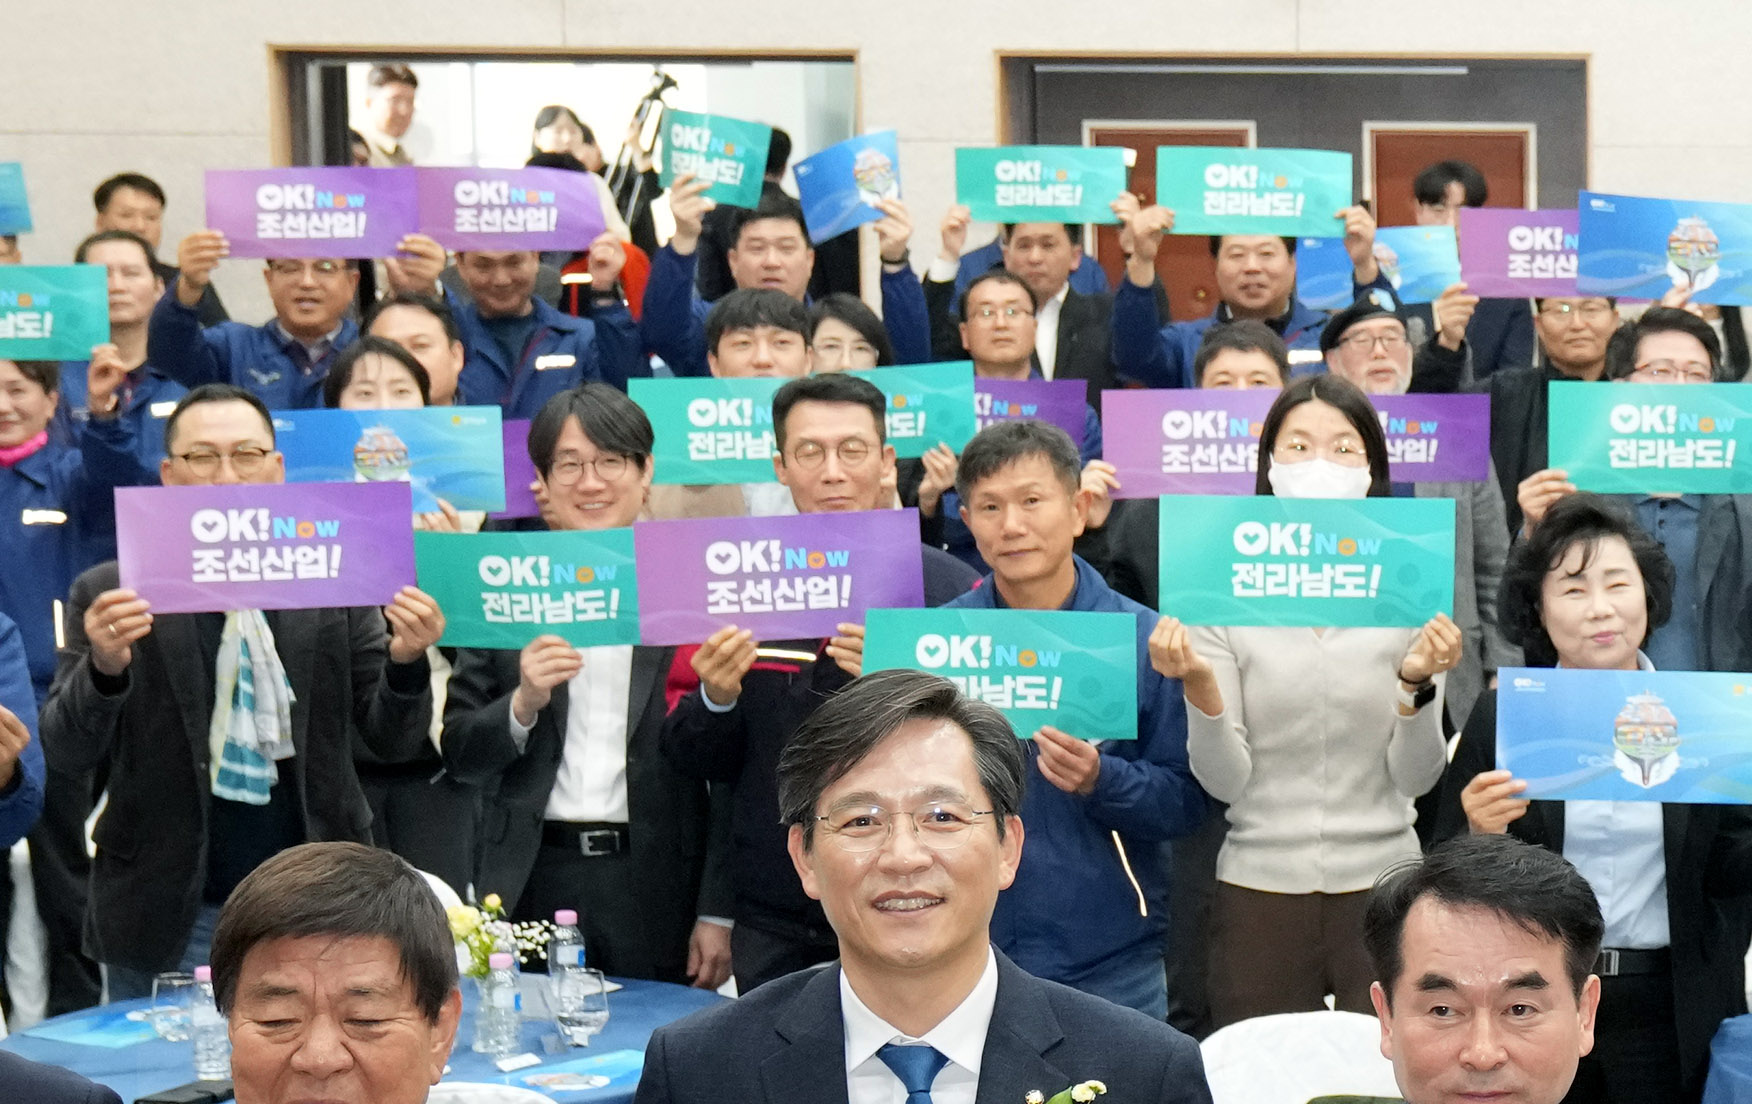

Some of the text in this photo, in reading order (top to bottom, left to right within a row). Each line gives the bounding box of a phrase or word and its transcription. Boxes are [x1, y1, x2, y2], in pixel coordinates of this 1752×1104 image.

[671, 123, 711, 152] OK!
[995, 160, 1041, 183] OK!
[1204, 164, 1302, 188] OK! Now
[256, 184, 365, 209] OK! Now
[455, 181, 554, 205] OK! Now
[996, 184, 1081, 206] 전라남도!
[1203, 191, 1304, 217] 전라남도!
[257, 212, 367, 239] 조선산업!
[456, 207, 559, 232] 조선산업!
[1508, 226, 1562, 250] OK!
[1508, 253, 1578, 279] 조선산
[688, 398, 752, 426] OK!
[993, 399, 1037, 416] Now
[1610, 404, 1734, 433] OK! Now
[1162, 411, 1262, 439] OK! No
[1389, 417, 1438, 434] Now
[688, 430, 777, 460] 전라남
[1608, 439, 1734, 469] 전라남도!
[191, 509, 339, 542] OK! Now
[1233, 522, 1381, 556] OK! Now
[192, 545, 341, 582] 조선산업!
[479, 556, 616, 586] OK! Now
[706, 541, 849, 573] OK! Now
[707, 575, 851, 614] 조선산업!
[1232, 564, 1381, 597] 전라남도!
[481, 588, 618, 625] 전라남도!
[916, 634, 1061, 668] OK! Now
